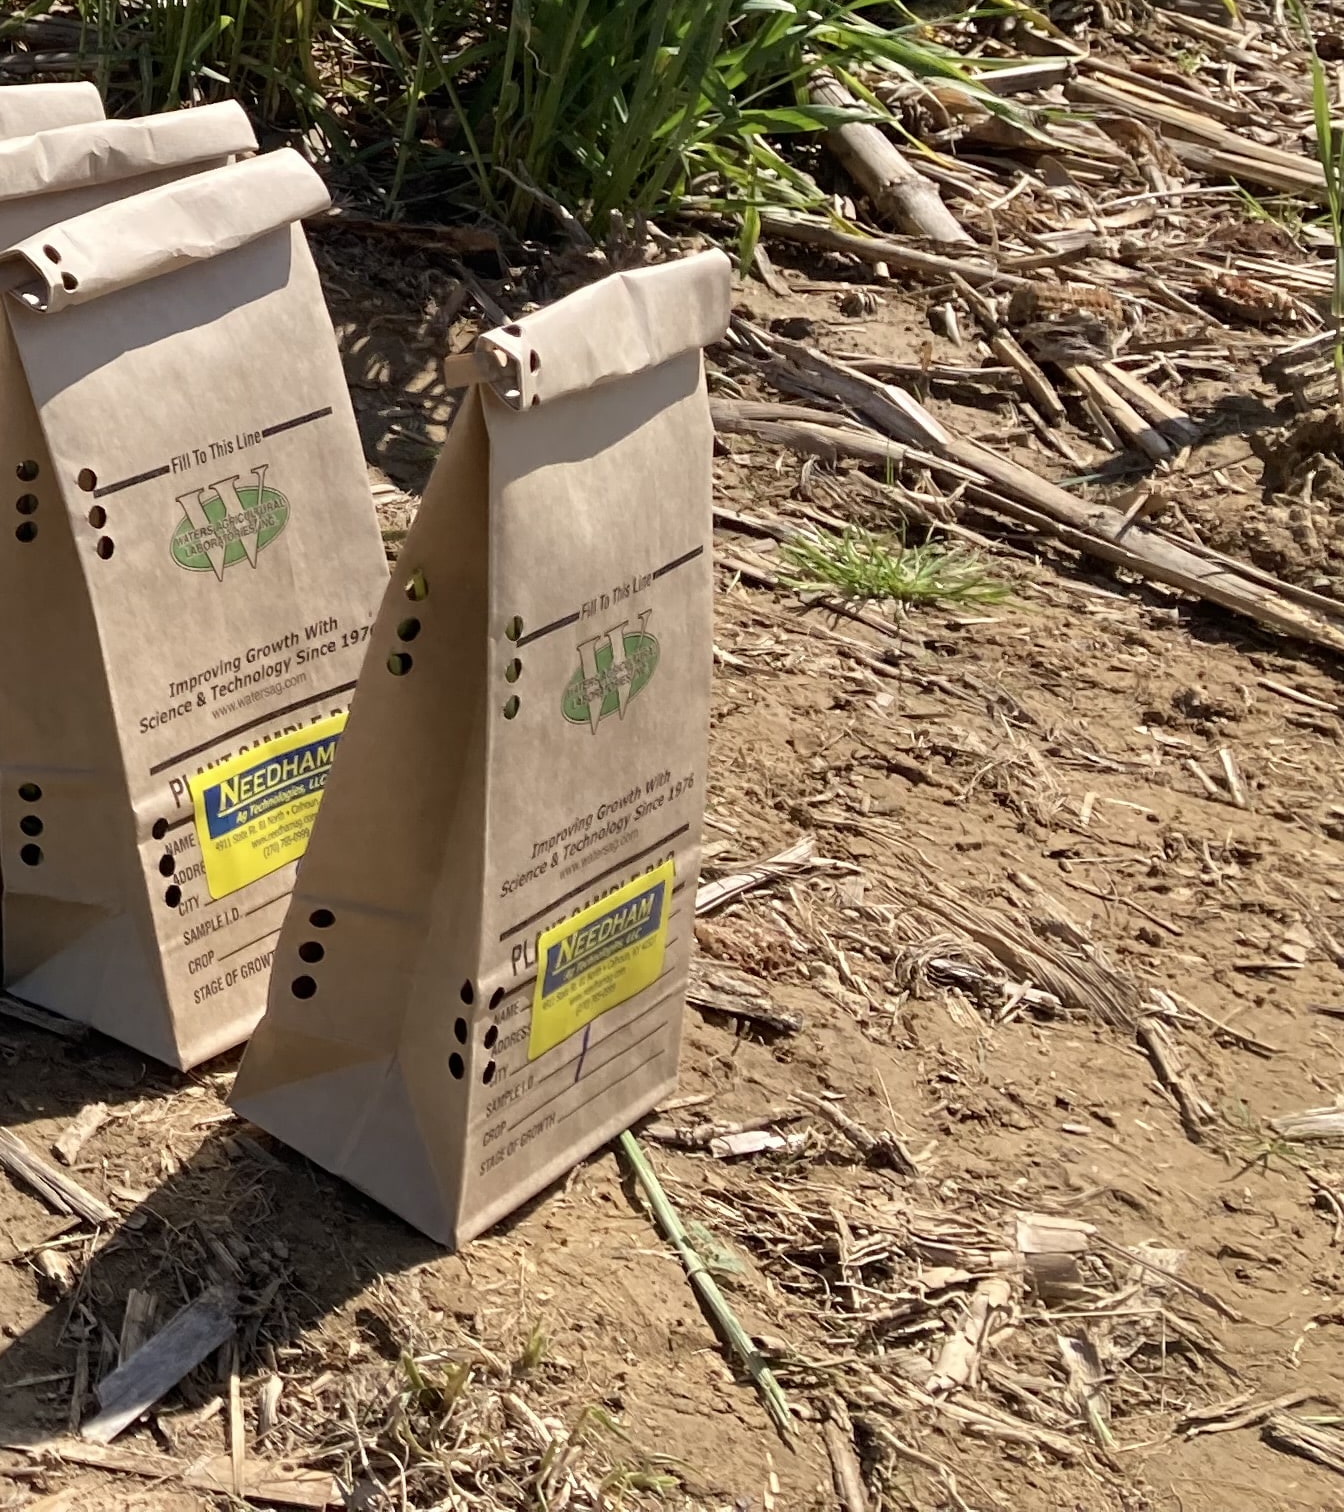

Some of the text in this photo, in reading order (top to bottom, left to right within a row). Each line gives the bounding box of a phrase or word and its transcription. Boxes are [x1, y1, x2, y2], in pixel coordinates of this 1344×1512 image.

[171, 431, 261, 474] Fill To This Line
[175, 524, 213, 546] WATERS
[600, 595, 609, 611] To
[613, 584, 630, 603] This
[633, 573, 652, 593] Line
[170, 617, 338, 698] Improving Growth With
[139, 700, 193, 734] Science
[197, 691, 207, 707] &
[210, 657, 291, 701] Technology
[296, 642, 336, 665] Since
[212, 672, 307, 719] www.watersag.com
[219, 742, 336, 811] NEEDHAM
[236, 812, 248, 824] Ag
[309, 774, 328, 789] LLC
[531, 770, 671, 860] Improving Growth With
[165, 833, 195, 856] NAME
[500, 772, 694, 897] Science & Technology Since 1976
[178, 896, 199, 917] CITY
[183, 919, 223, 946] SAMPLE
[556, 891, 655, 969] NEEDHAM
[188, 950, 214, 975] CROP
[194, 977, 224, 1004] STAGE
[225, 969, 238, 986] OF
[494, 1000, 521, 1026] NAME
[486, 1087, 521, 1118] SAMPLE
[480, 1112, 556, 1176] STAGE OF GROWTH
[482, 1121, 507, 1147] CROP
